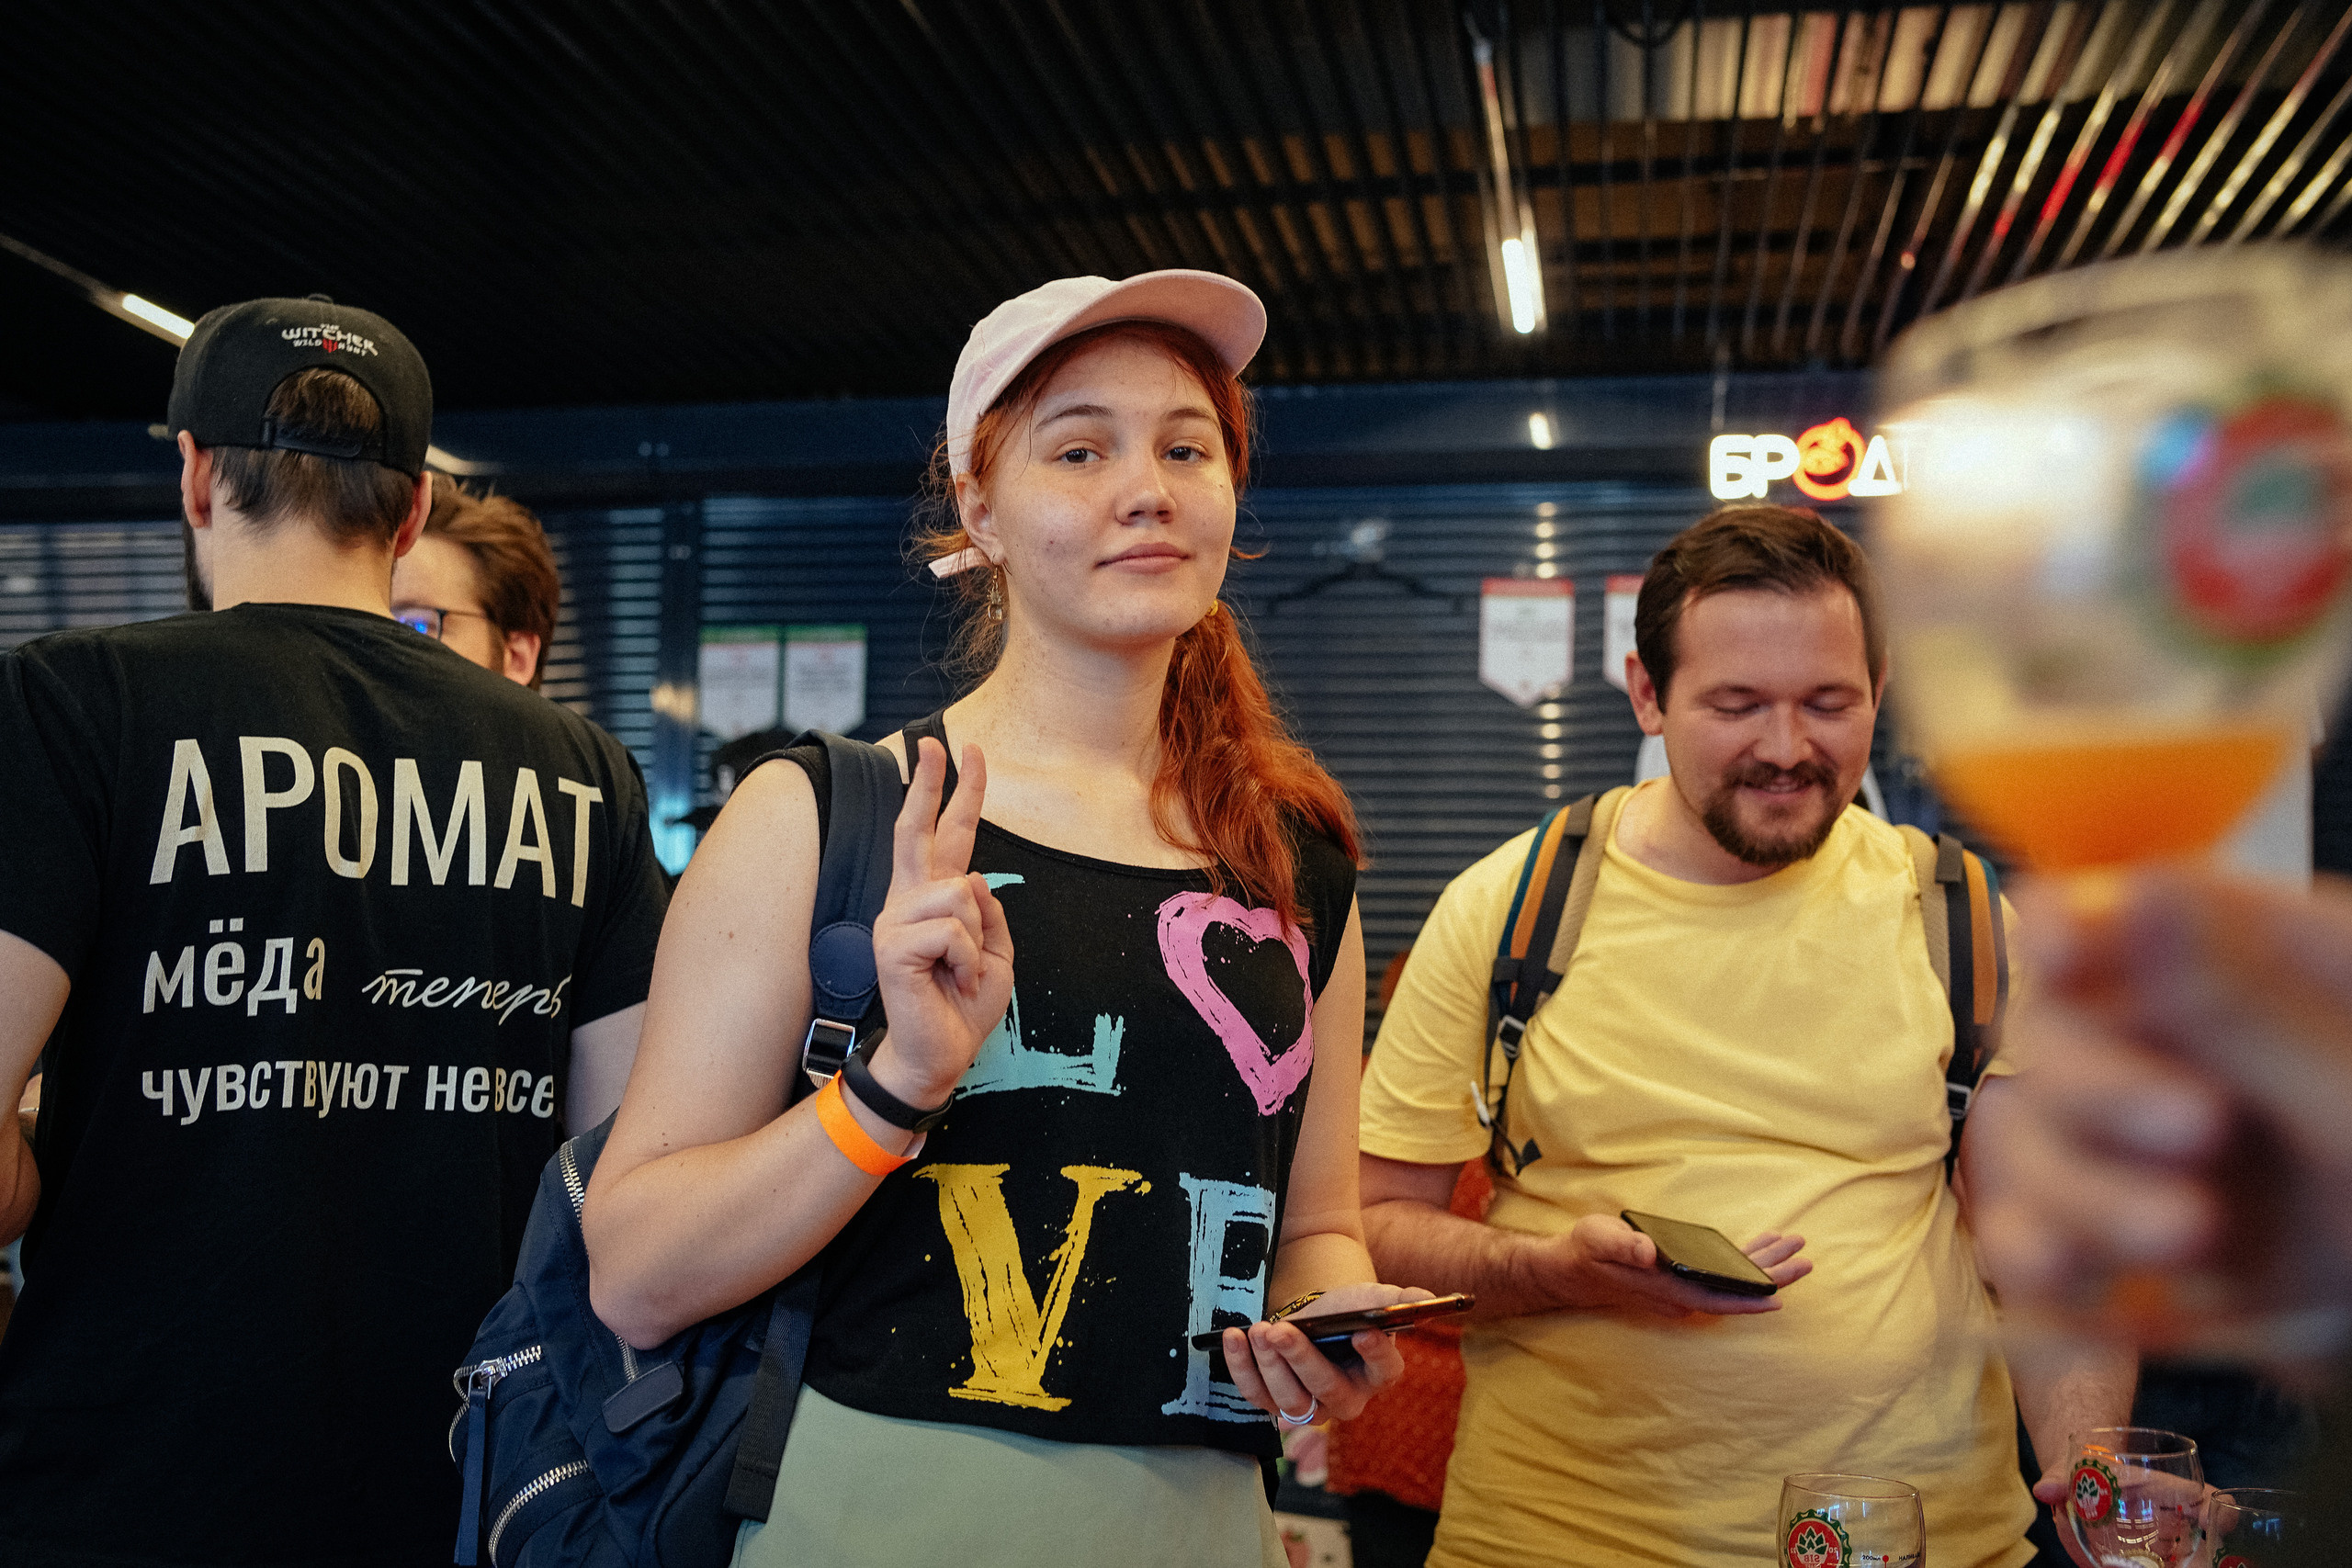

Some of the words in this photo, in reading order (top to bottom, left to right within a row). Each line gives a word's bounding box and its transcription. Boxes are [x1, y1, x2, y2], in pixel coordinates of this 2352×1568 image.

[281, 327, 379, 356] WITCHER
[293, 338, 322, 347] WILD
[150, 736, 604, 908] АРОМАТ
[142, 917, 326, 1018] мёда
[361, 968, 572, 1026] теперь
[141, 1060, 410, 1126] чувствуют
